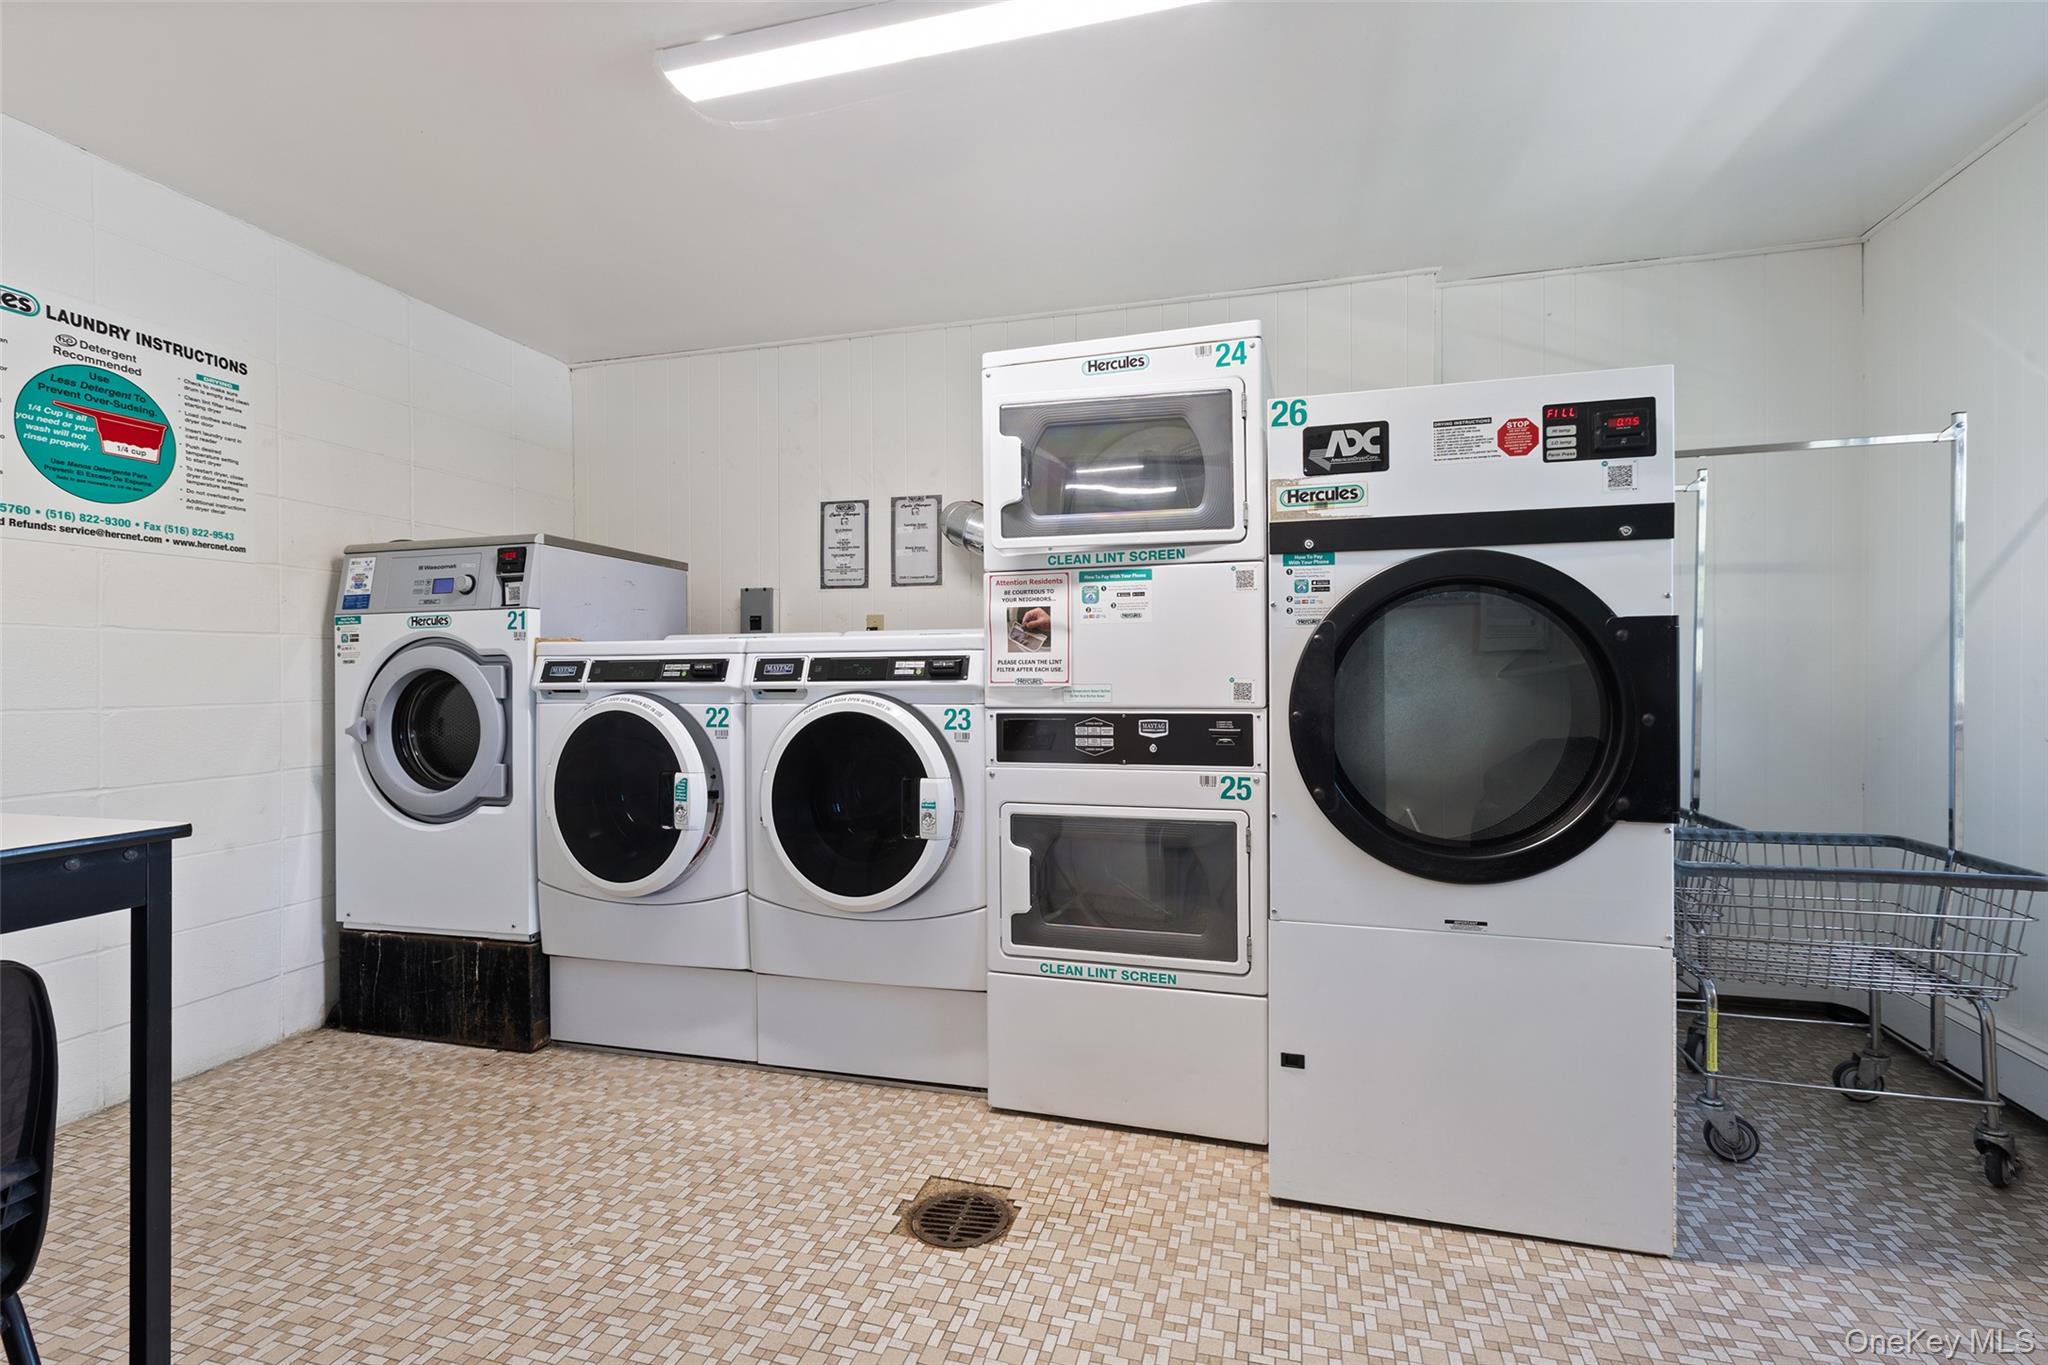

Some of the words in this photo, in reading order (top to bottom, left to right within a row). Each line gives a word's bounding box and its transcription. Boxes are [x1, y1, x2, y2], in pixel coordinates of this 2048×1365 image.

[46, 305, 130, 342] LAUNDRY
[136, 332, 248, 376] INSTRUCTIONS
[53, 345, 142, 376] Recommended
[80, 340, 136, 363] Detergent
[1216, 340, 1247, 368] 24
[1088, 356, 1145, 372] Hercules
[89, 372, 110, 383] Use
[184, 378, 201, 387] Check
[38, 382, 81, 400] Prevent
[50, 374, 76, 388] Less
[80, 381, 132, 401] Detergent
[135, 394, 146, 403] To
[28, 403, 41, 412] 1/4
[44, 407, 62, 418] Cup
[66, 410, 72, 418] is
[76, 412, 87, 422] all
[1271, 399, 1308, 427] 26
[1546, 408, 1575, 418] FILL
[16, 412, 32, 422] you
[36, 414, 59, 426] need
[75, 424, 96, 435] your
[25, 422, 50, 434] wash
[54, 426, 70, 437] will
[72, 430, 87, 440] not
[1506, 420, 1529, 429] STOP
[24, 432, 48, 443] rinse
[1325, 427, 1380, 458] ADC
[117, 444, 128, 453] 1/4
[132, 448, 146, 458] cup
[1287, 486, 1358, 503] Hercules
[0, 503, 31, 516] 5760
[46, 508, 76, 522] (516)
[80, 513, 132, 529] 822-9300
[144, 520, 162, 532] Fax
[164, 524, 190, 537] (516)
[192, 528, 235, 542] 822-9543
[9, 518, 56, 532] Refunds:
[59, 525, 162, 544] service@hercnet.com
[172, 538, 246, 553] www.hercnet.com
[1048, 554, 1091, 566] CLEAN
[1095, 552, 1125, 564] LINT
[1129, 548, 1186, 562] SCREEN
[996, 579, 1028, 587] Attention
[411, 616, 449, 627] Hercules
[507, 611, 526, 630] 21
[765, 664, 794, 672] MAYTAG
[706, 707, 730, 728] 22
[944, 708, 972, 730] 23
[1220, 776, 1252, 801] 25
[1040, 963, 1083, 976] CLEAN
[1088, 967, 1117, 979] LINT
[1121, 970, 1176, 985] SCREEN
